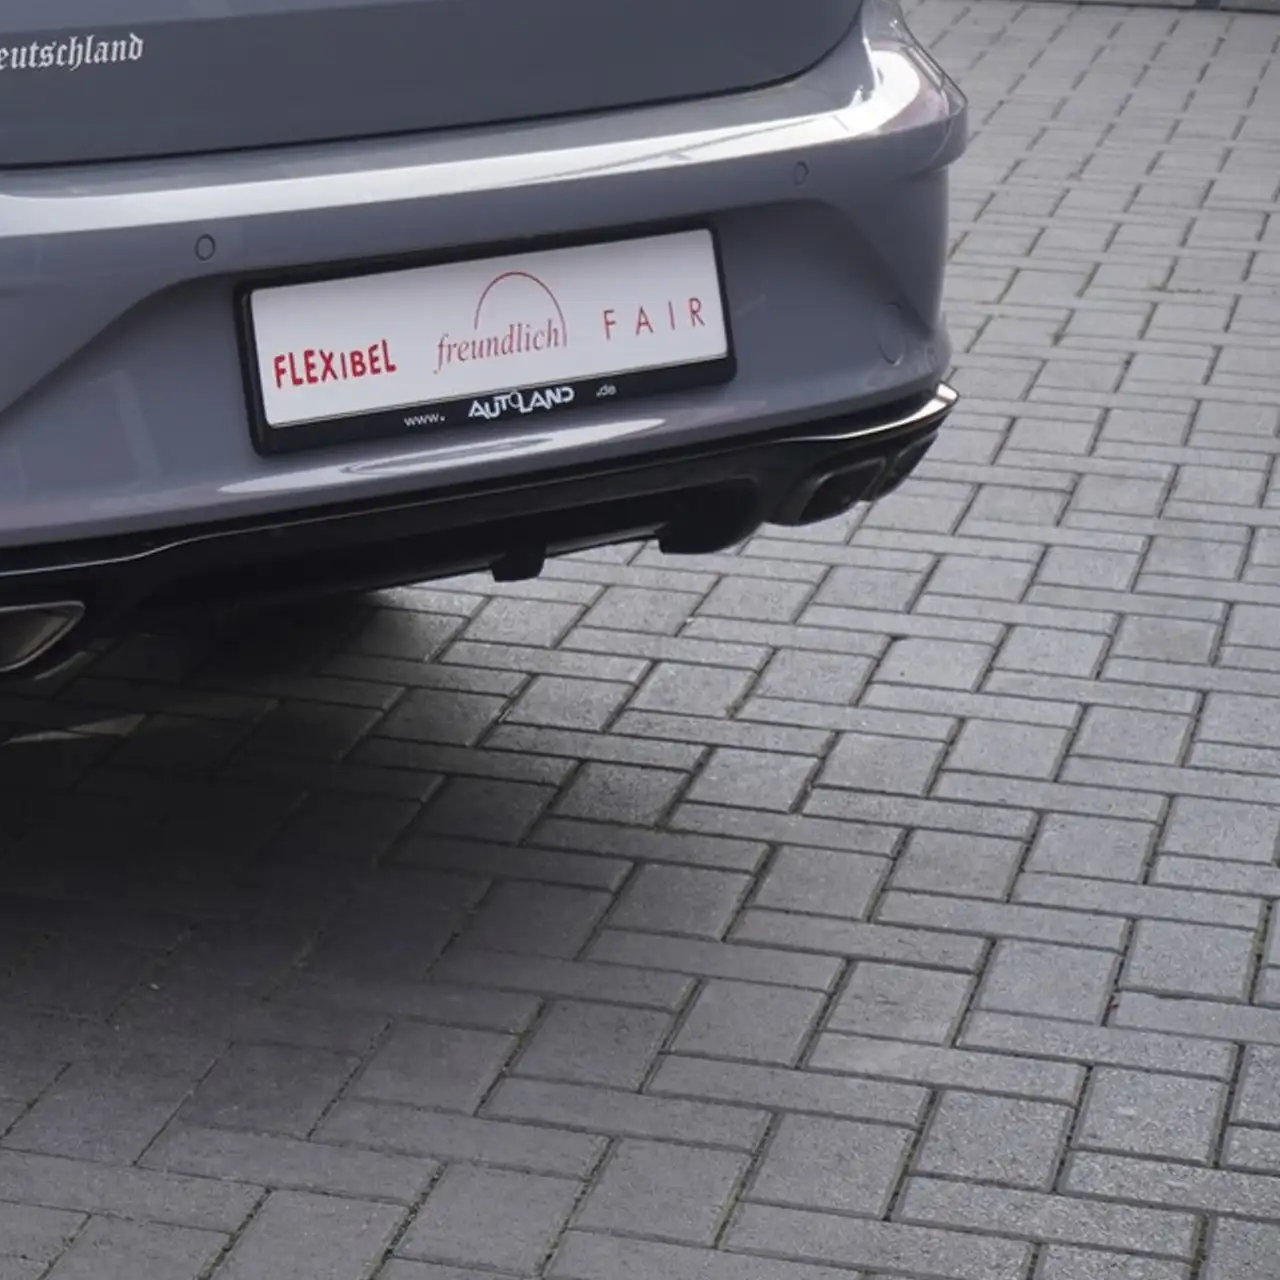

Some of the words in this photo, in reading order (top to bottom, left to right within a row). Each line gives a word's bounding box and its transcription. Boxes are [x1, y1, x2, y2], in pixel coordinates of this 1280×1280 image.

[273, 339, 397, 389] FLEXIBEL
[433, 319, 561, 375] freundlich
[603, 296, 706, 340] FAIR
[468, 386, 575, 419] AUTOLAND
